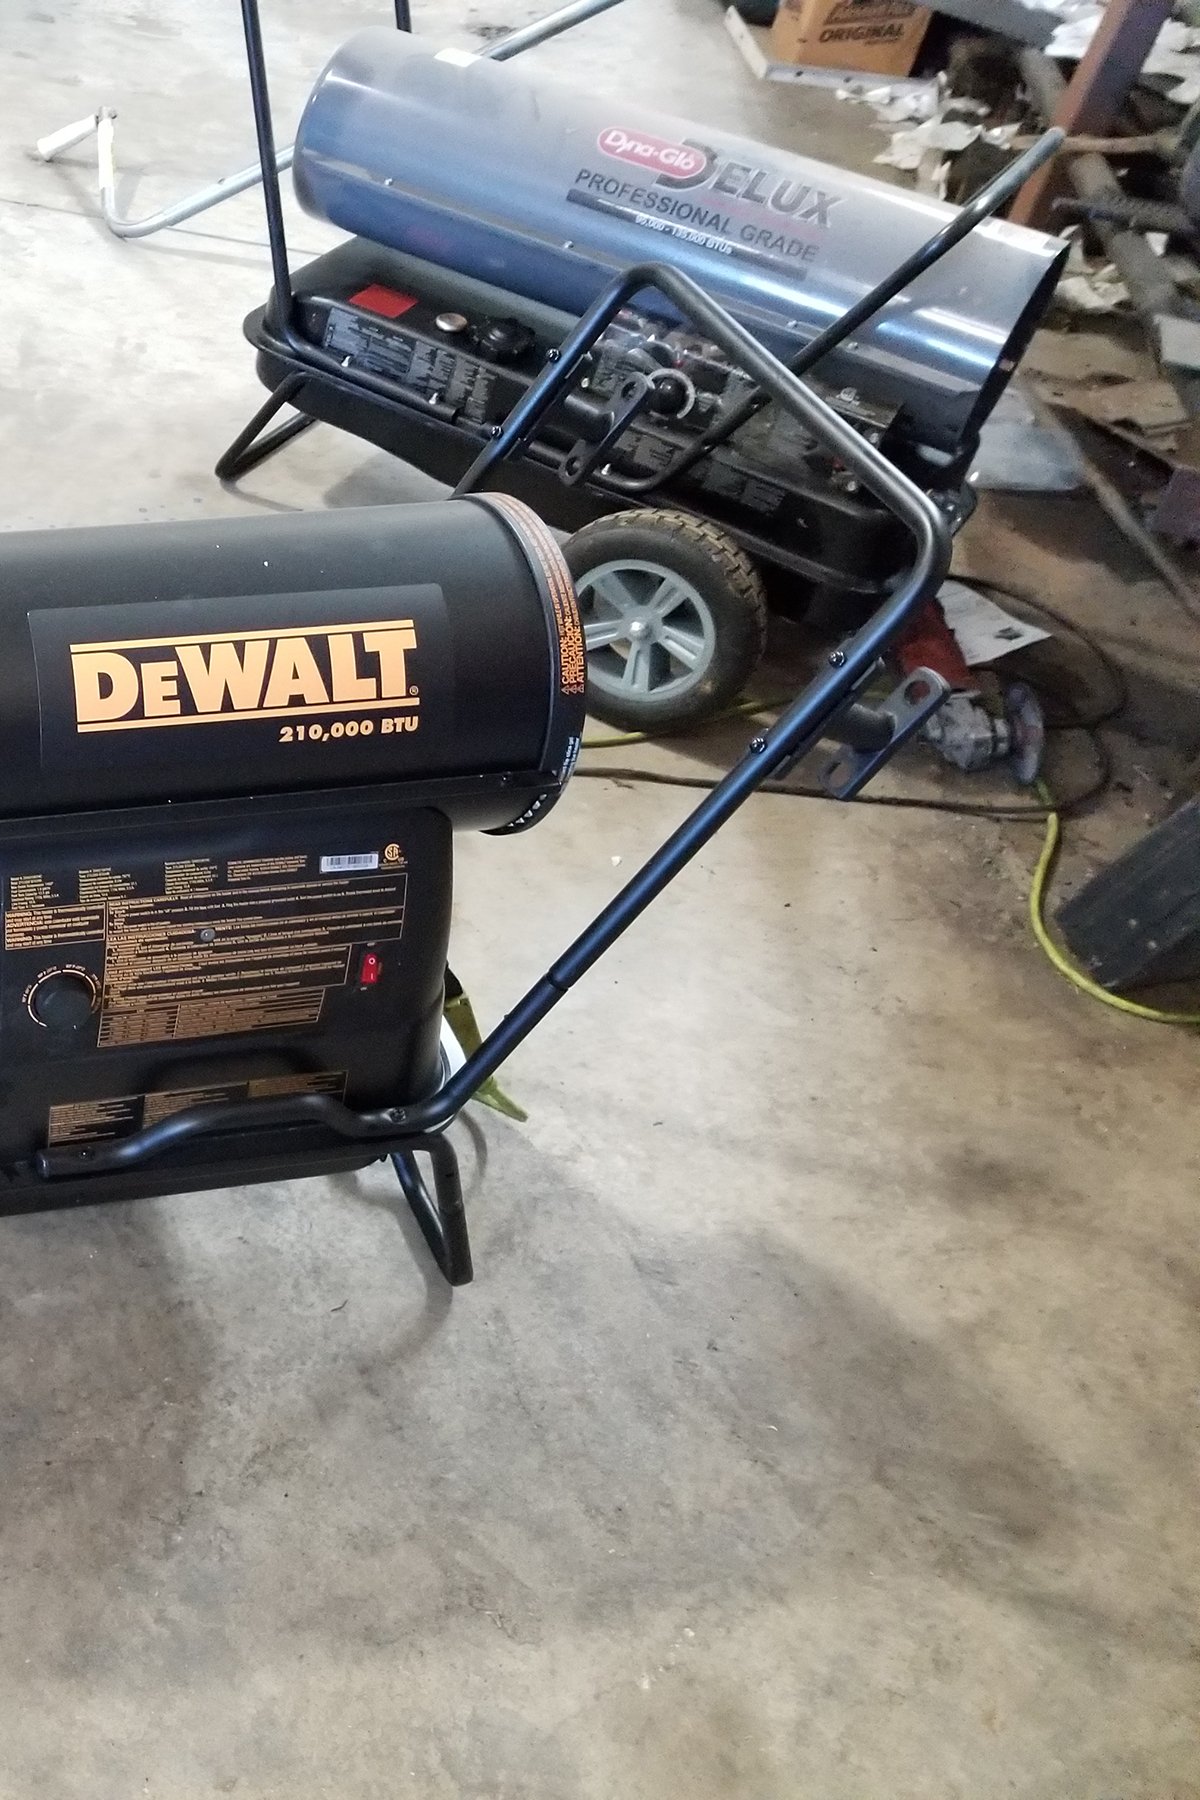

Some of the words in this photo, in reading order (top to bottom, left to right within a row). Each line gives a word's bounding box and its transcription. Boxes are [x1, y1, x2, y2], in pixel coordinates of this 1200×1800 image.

[819, 23, 904, 43] ORIGINAL
[576, 169, 734, 234] PROFESSIONAL
[740, 224, 820, 262] GRADE
[279, 720, 374, 742] 210,000
[381, 716, 419, 734] BTU
